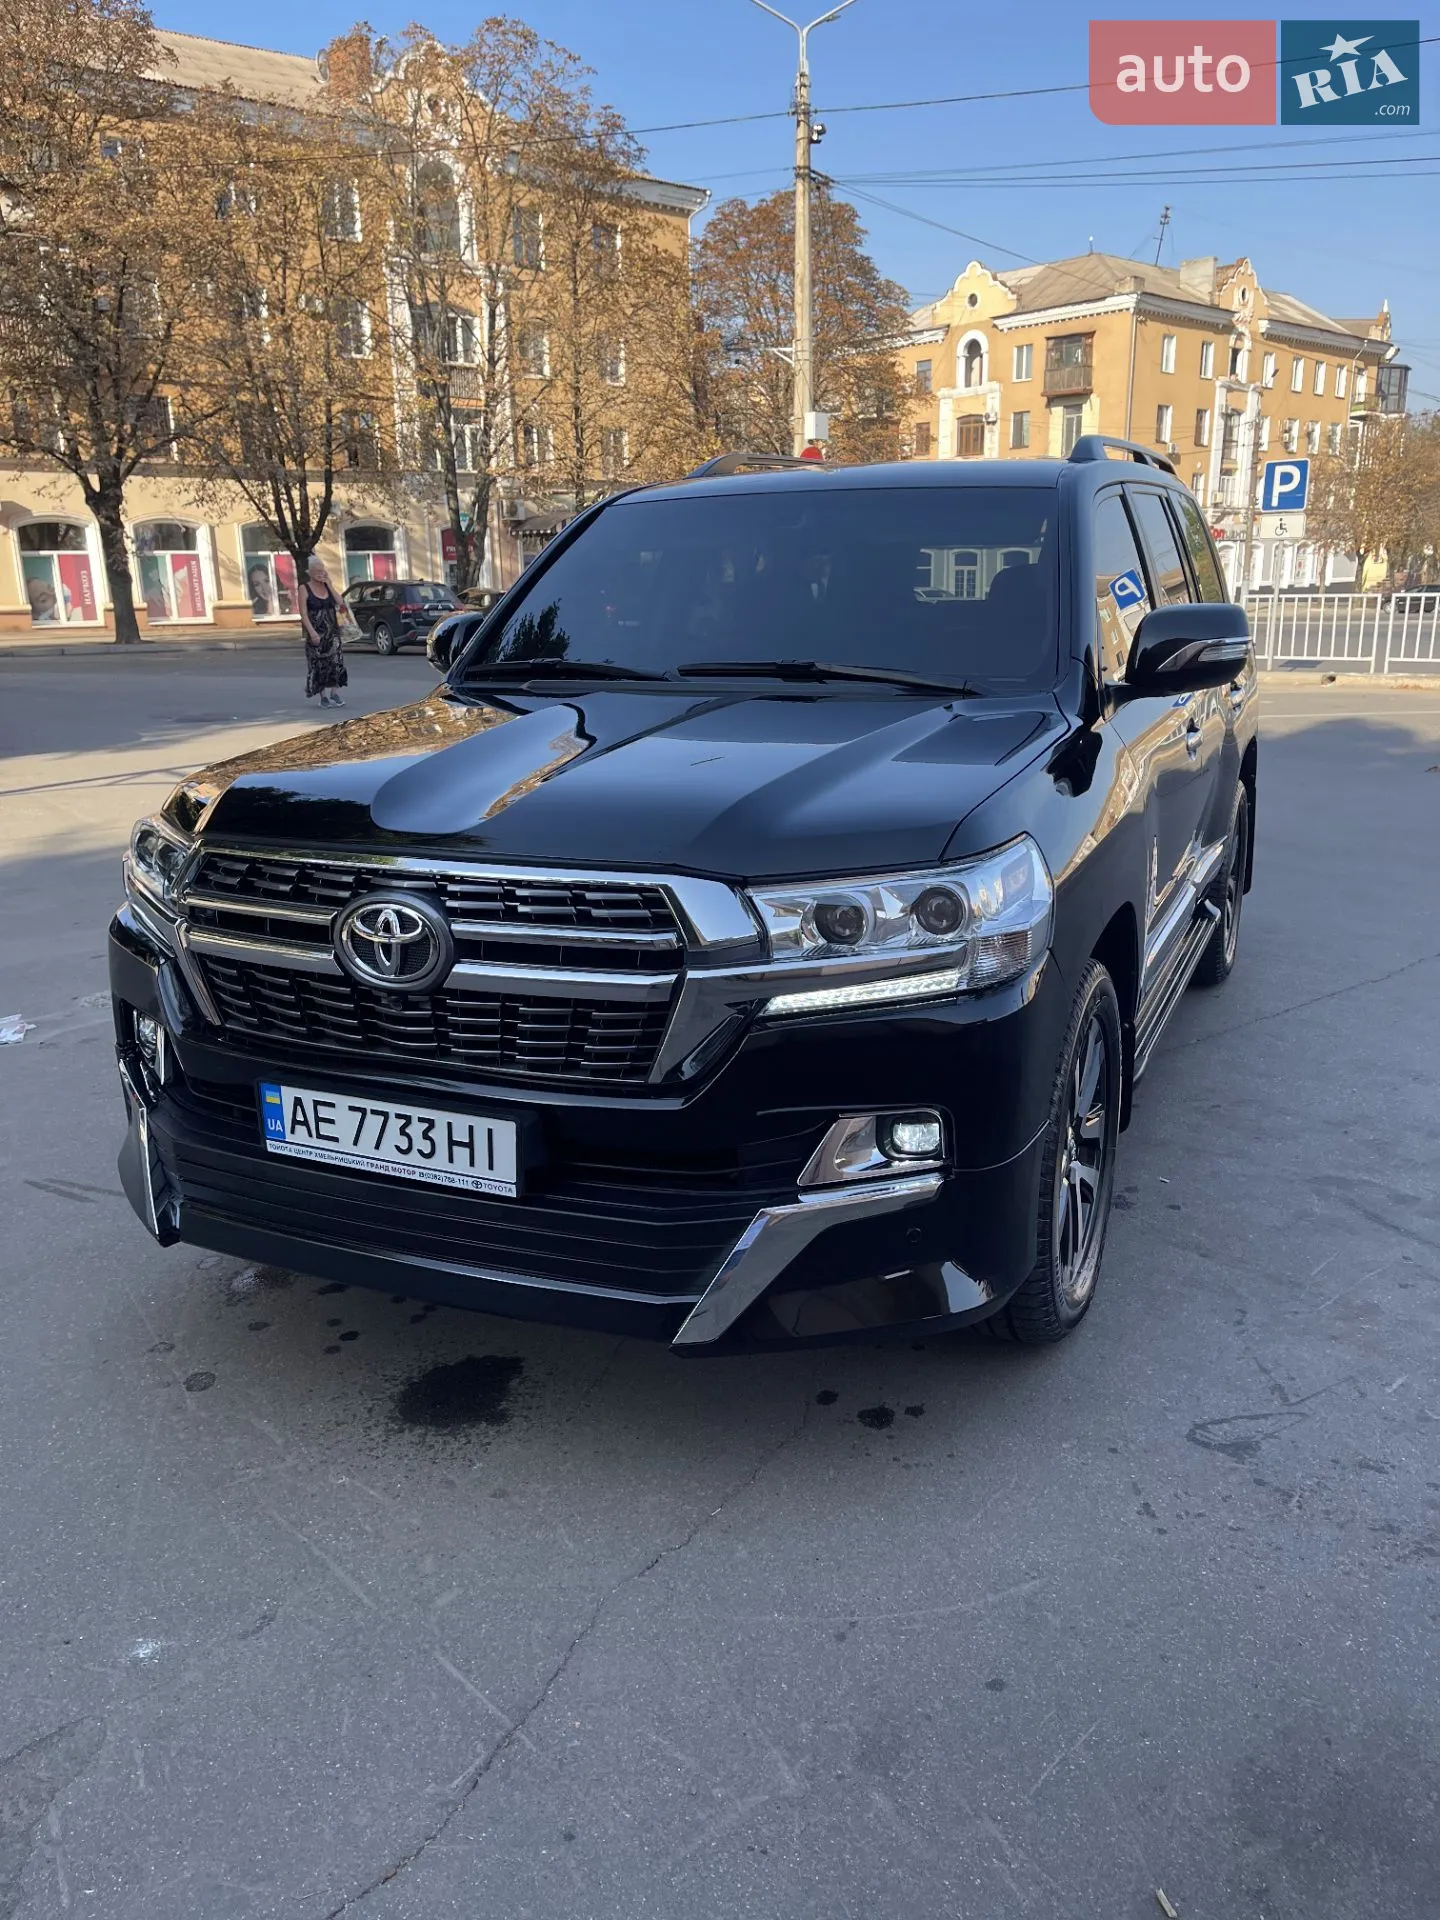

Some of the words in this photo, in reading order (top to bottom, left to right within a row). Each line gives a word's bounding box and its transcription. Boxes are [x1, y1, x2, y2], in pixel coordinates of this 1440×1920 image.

[1271, 465, 1301, 507] P
[267, 1118, 284, 1132] UA
[290, 1096, 339, 1143] AE
[348, 1105, 436, 1159] 7733
[293, 1148, 314, 1158] ЦЕНТР
[366, 1162, 391, 1174] ГРАНД
[391, 1166, 416, 1176] МОТОР
[483, 1182, 513, 1194] TOYOTA
